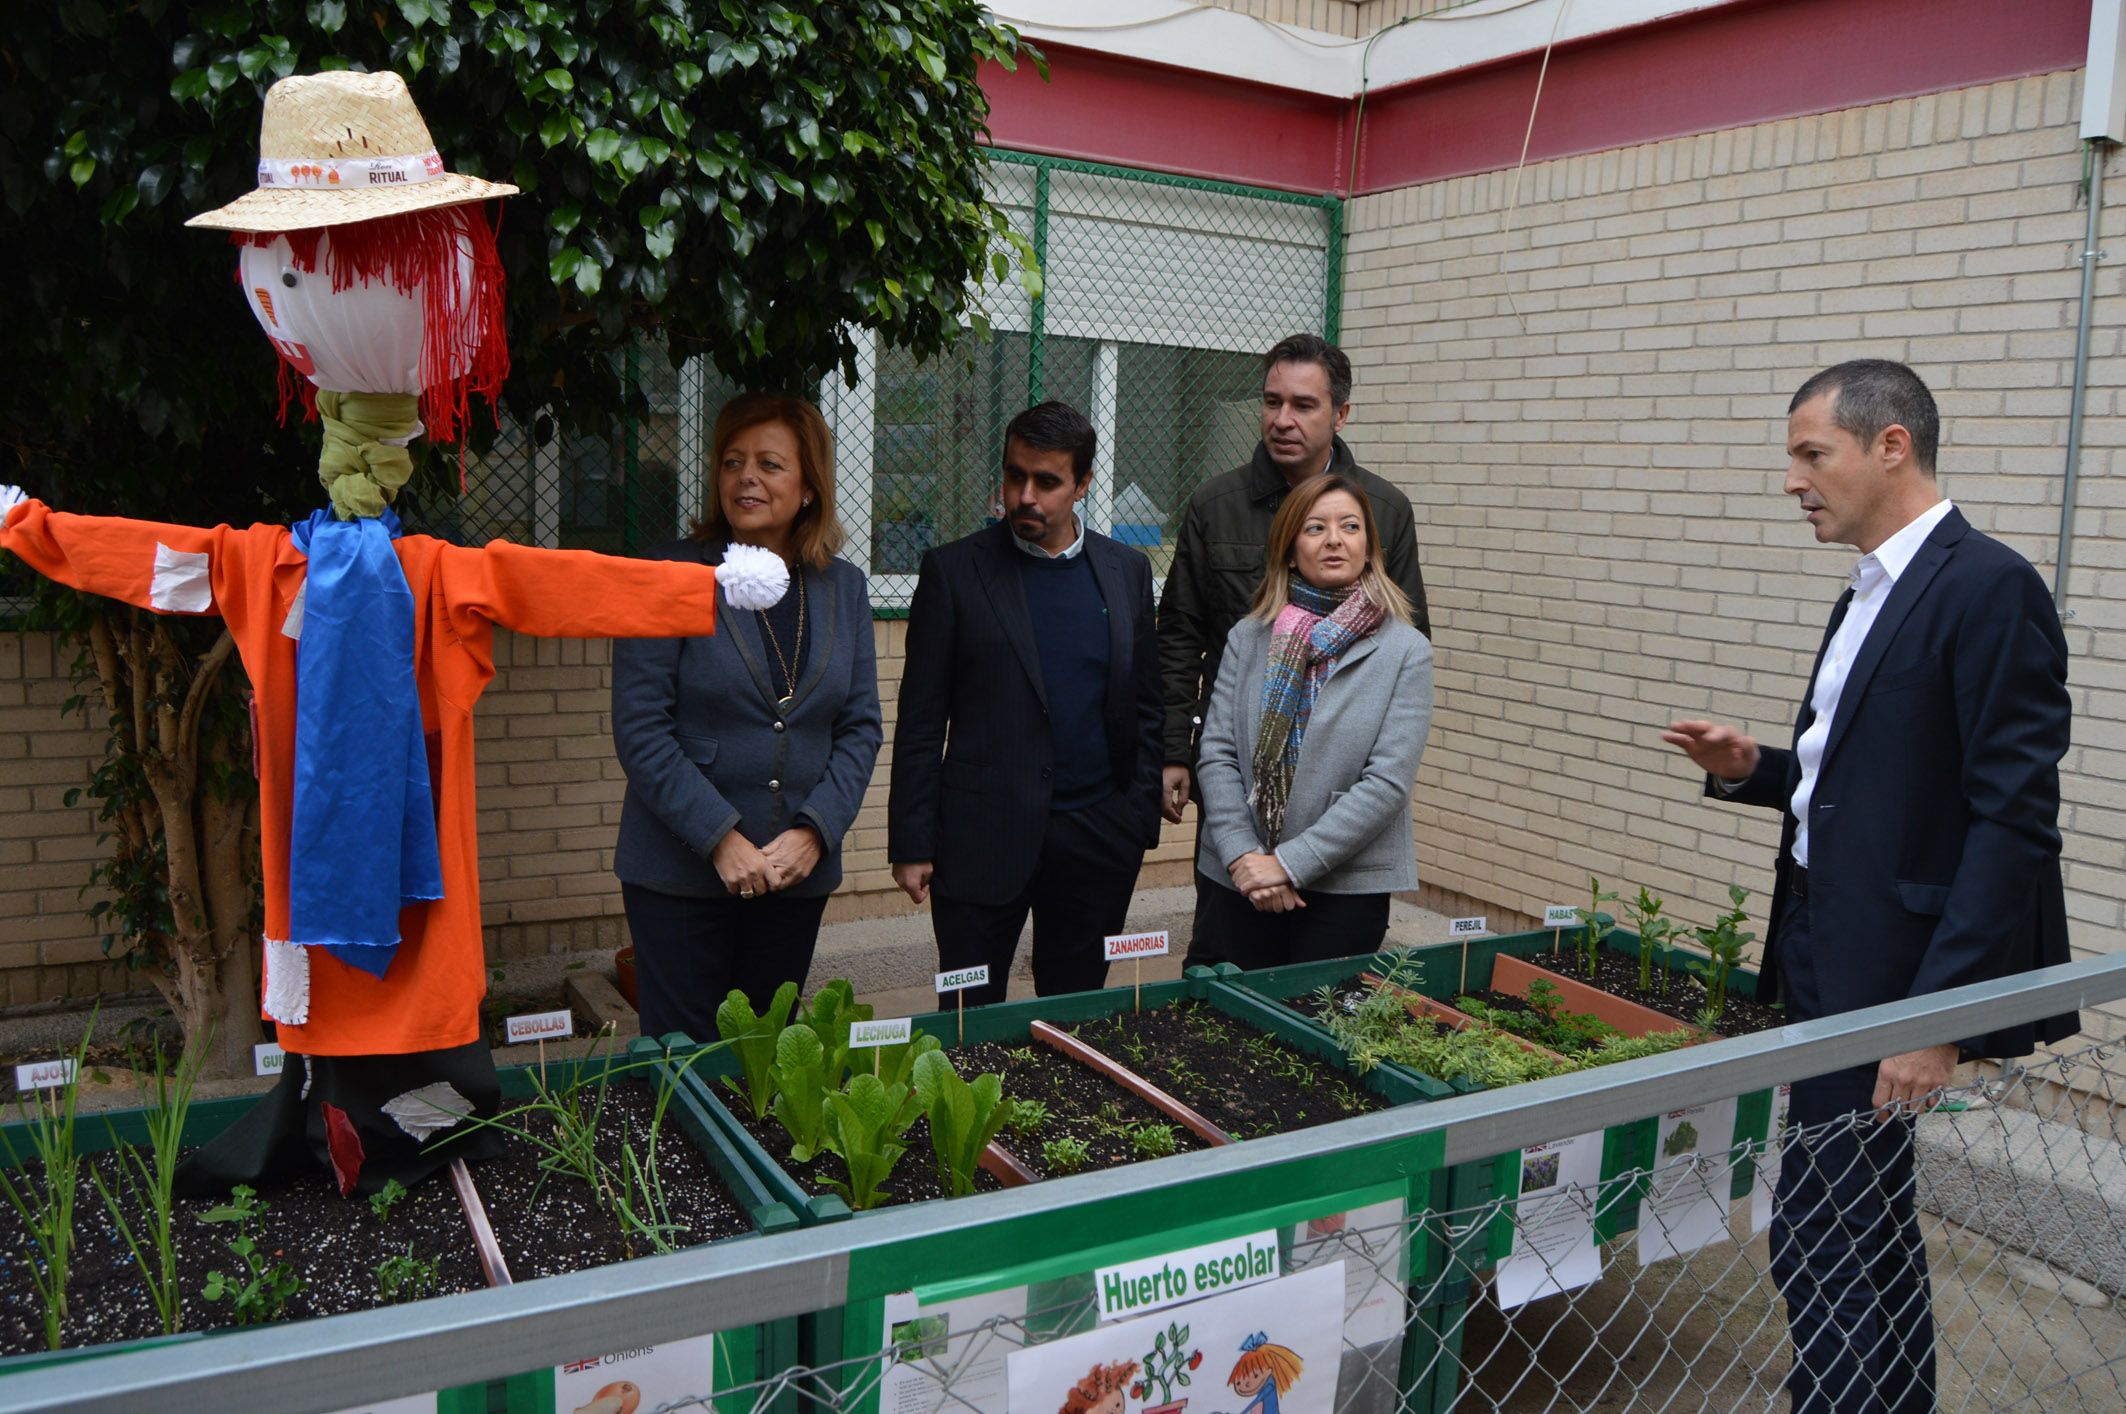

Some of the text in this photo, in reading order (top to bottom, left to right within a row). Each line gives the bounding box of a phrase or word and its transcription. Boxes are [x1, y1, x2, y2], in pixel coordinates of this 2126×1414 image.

[369, 171, 408, 184] RITUAL
[1548, 909, 1573, 920] HABAS
[1454, 919, 1482, 932] PEREJIL
[1109, 935, 1165, 955] ZANAHORIAS
[942, 969, 986, 988] ACELGAS
[510, 1016, 566, 1037] CEBOLLAS
[856, 1023, 907, 1043] LECHUGA
[262, 1054, 282, 1068] GUI
[31, 1063, 70, 1083] AJOS
[1102, 1261, 1188, 1314] Huerto
[1194, 1241, 1276, 1292] escolar
[603, 1344, 655, 1366] Onions
